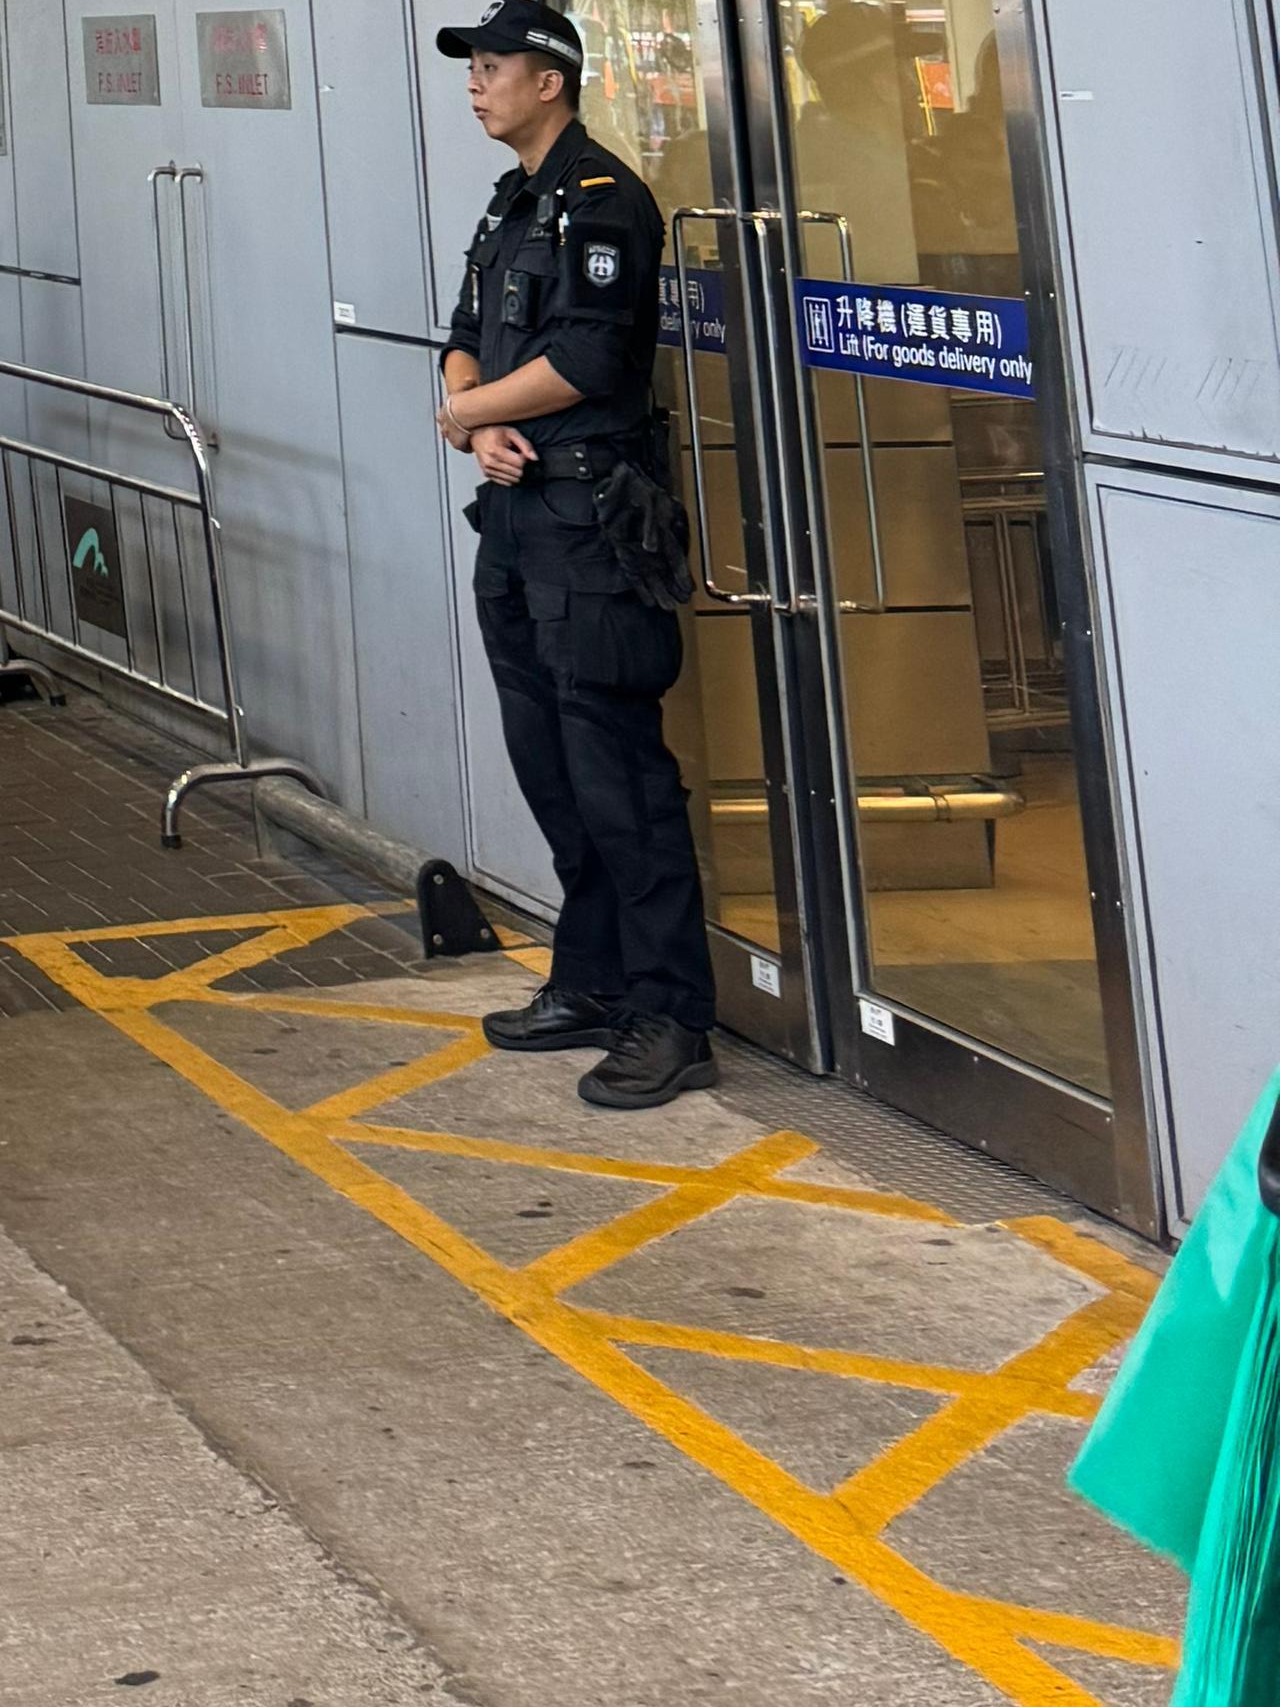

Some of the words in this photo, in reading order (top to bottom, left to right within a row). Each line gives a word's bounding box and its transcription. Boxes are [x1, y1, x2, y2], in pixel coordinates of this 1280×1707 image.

[839, 331, 861, 358] Lift
[863, 335, 888, 361] (For
[892, 342, 935, 368] goods
[939, 345, 994, 379] delivery
[999, 354, 1033, 385] only
